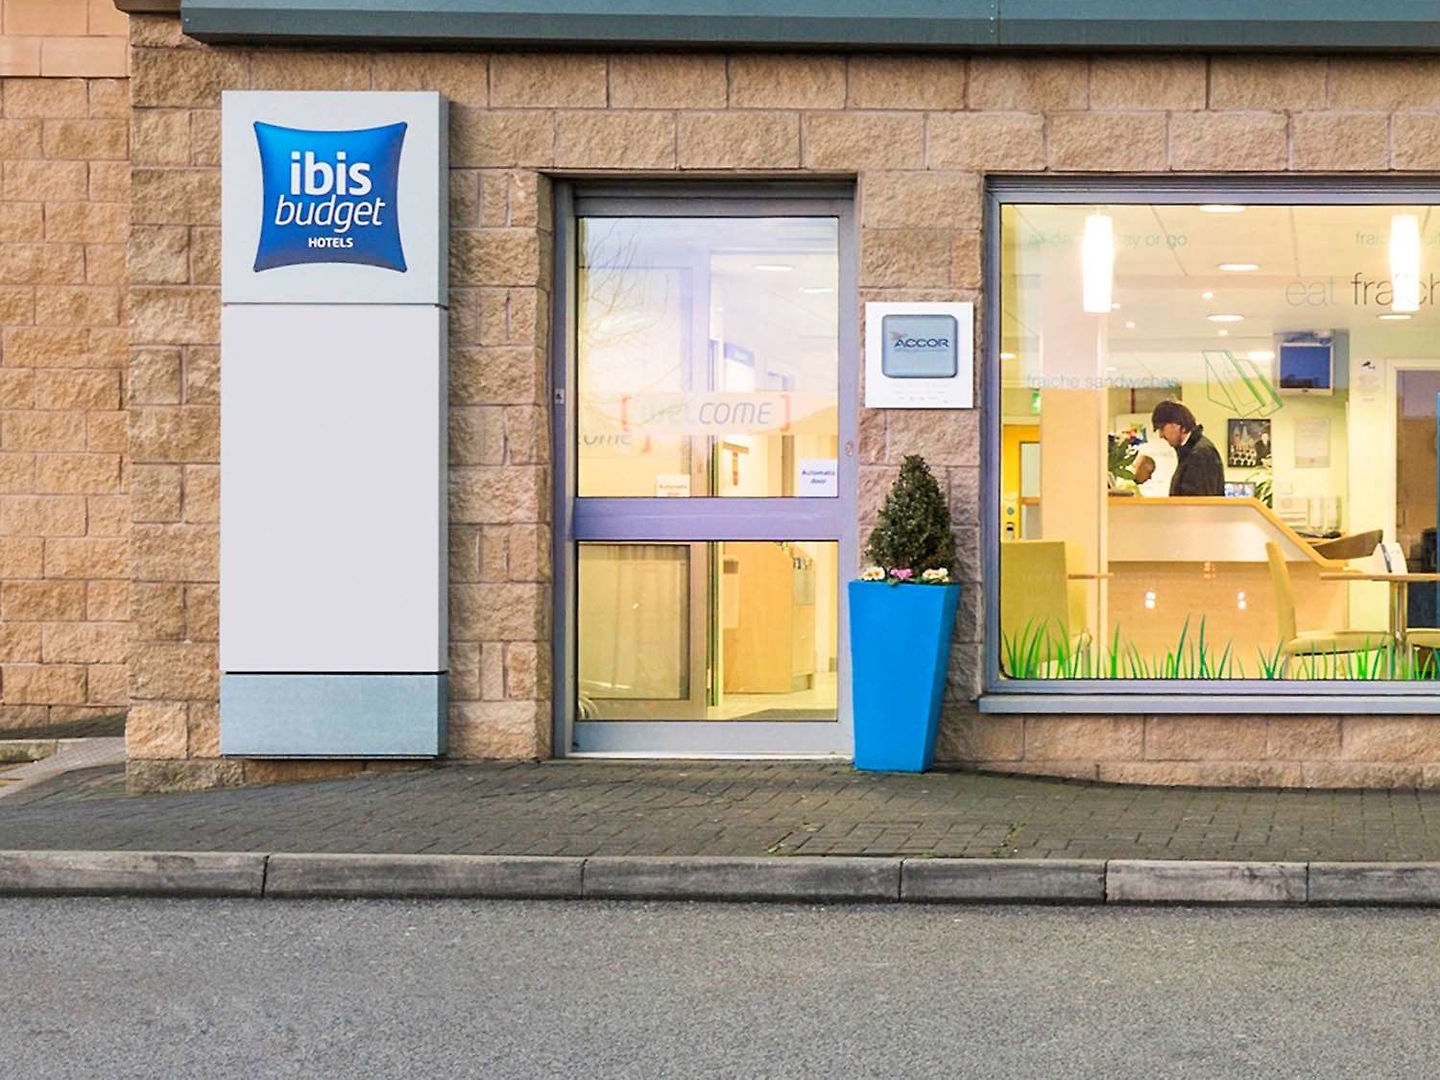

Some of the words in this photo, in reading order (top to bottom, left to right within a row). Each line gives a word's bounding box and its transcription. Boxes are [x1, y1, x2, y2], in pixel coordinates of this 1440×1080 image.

[290, 151, 373, 196] ibis
[274, 194, 386, 234] budget
[308, 237, 354, 248] HOTELS
[1166, 235, 1189, 250] go
[1285, 275, 1337, 307] eat
[893, 337, 950, 348] ACCOR
